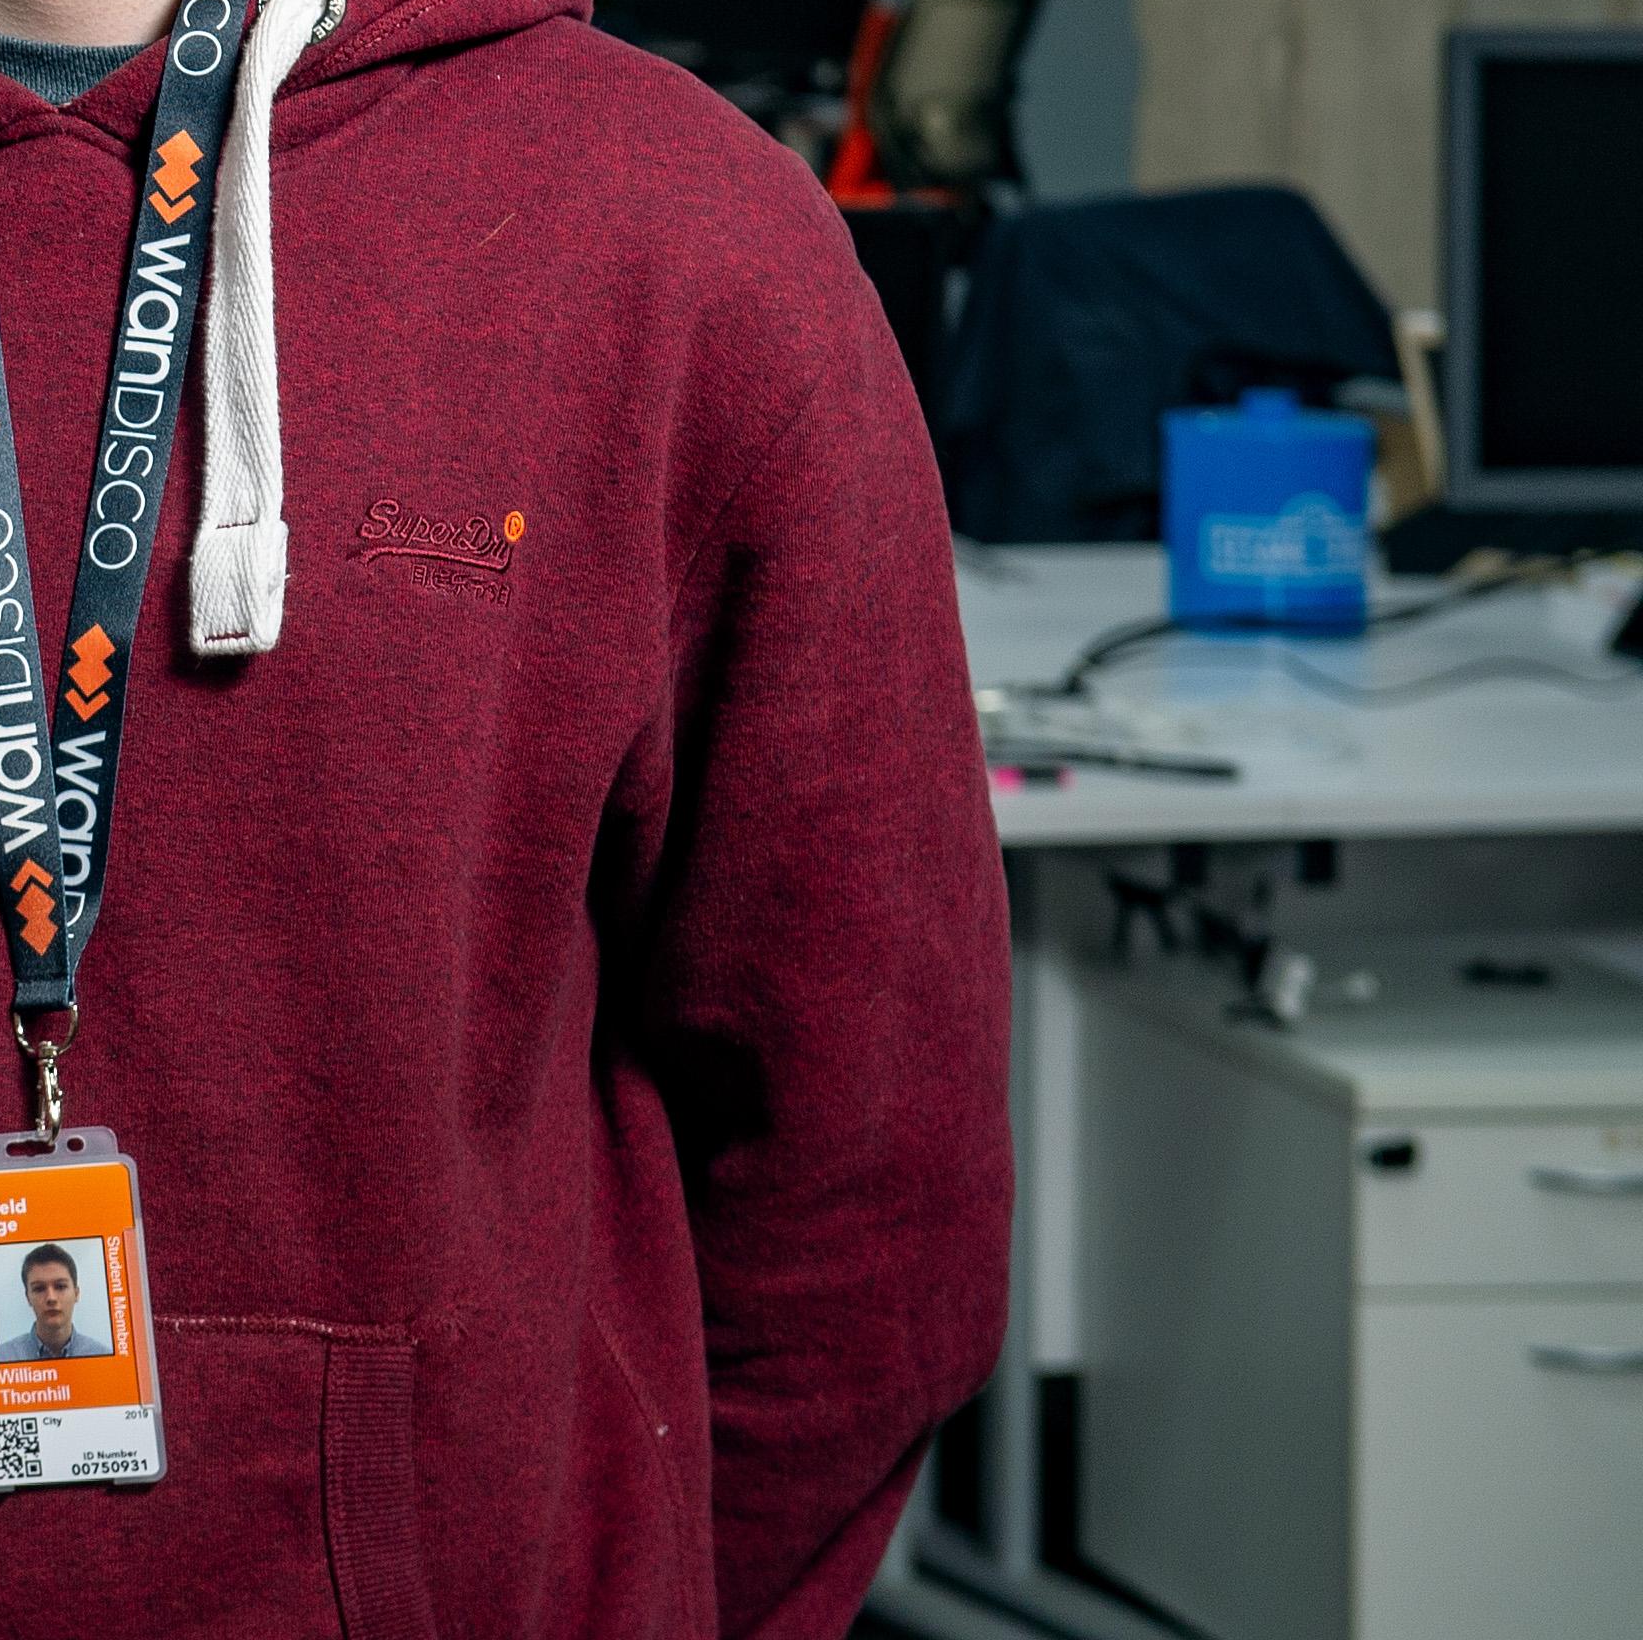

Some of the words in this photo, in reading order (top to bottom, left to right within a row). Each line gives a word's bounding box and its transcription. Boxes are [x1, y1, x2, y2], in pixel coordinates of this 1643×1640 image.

[107, 1235, 123, 1293] Student
[113, 1296, 129, 1357] Member
[0, 1384, 71, 1406] Thornhill
[42, 1416, 62, 1427] City
[82, 1451, 95, 1461] ID
[97, 1450, 138, 1460] Number
[71, 1458, 148, 1476] 00750931
